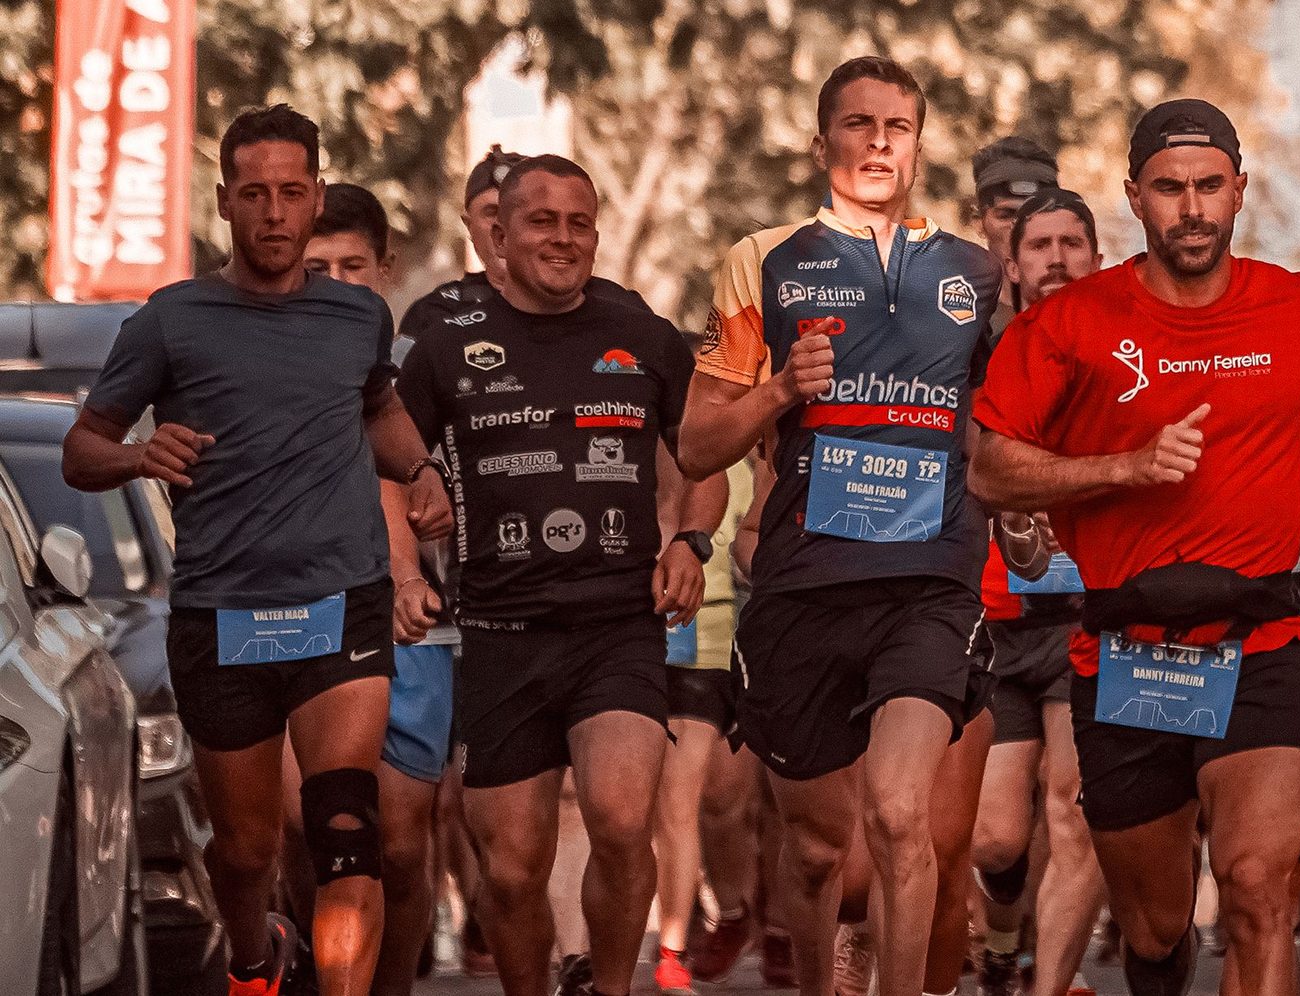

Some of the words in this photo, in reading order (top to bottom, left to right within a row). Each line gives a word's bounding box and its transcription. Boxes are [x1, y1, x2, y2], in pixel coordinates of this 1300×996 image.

[119, 36, 171, 112] DE
[115, 121, 167, 264] MIRA
[807, 285, 865, 302] Fátima
[444, 311, 487, 327] NEO
[1158, 358, 1211, 375] Danny
[1213, 352, 1271, 370] Ferreira
[806, 372, 959, 409] oelhinhos
[470, 406, 555, 430] transfor
[574, 401, 646, 418] coelhinhos
[887, 408, 950, 429] trucks
[480, 453, 555, 472] CELESTINO
[822, 446, 858, 467] LUT
[861, 454, 908, 479] 3029
[918, 460, 941, 478] TP
[846, 481, 874, 496] EDGAR
[1133, 667, 1164, 682] DANNY
[1164, 670, 1206, 688] FERREIRA
